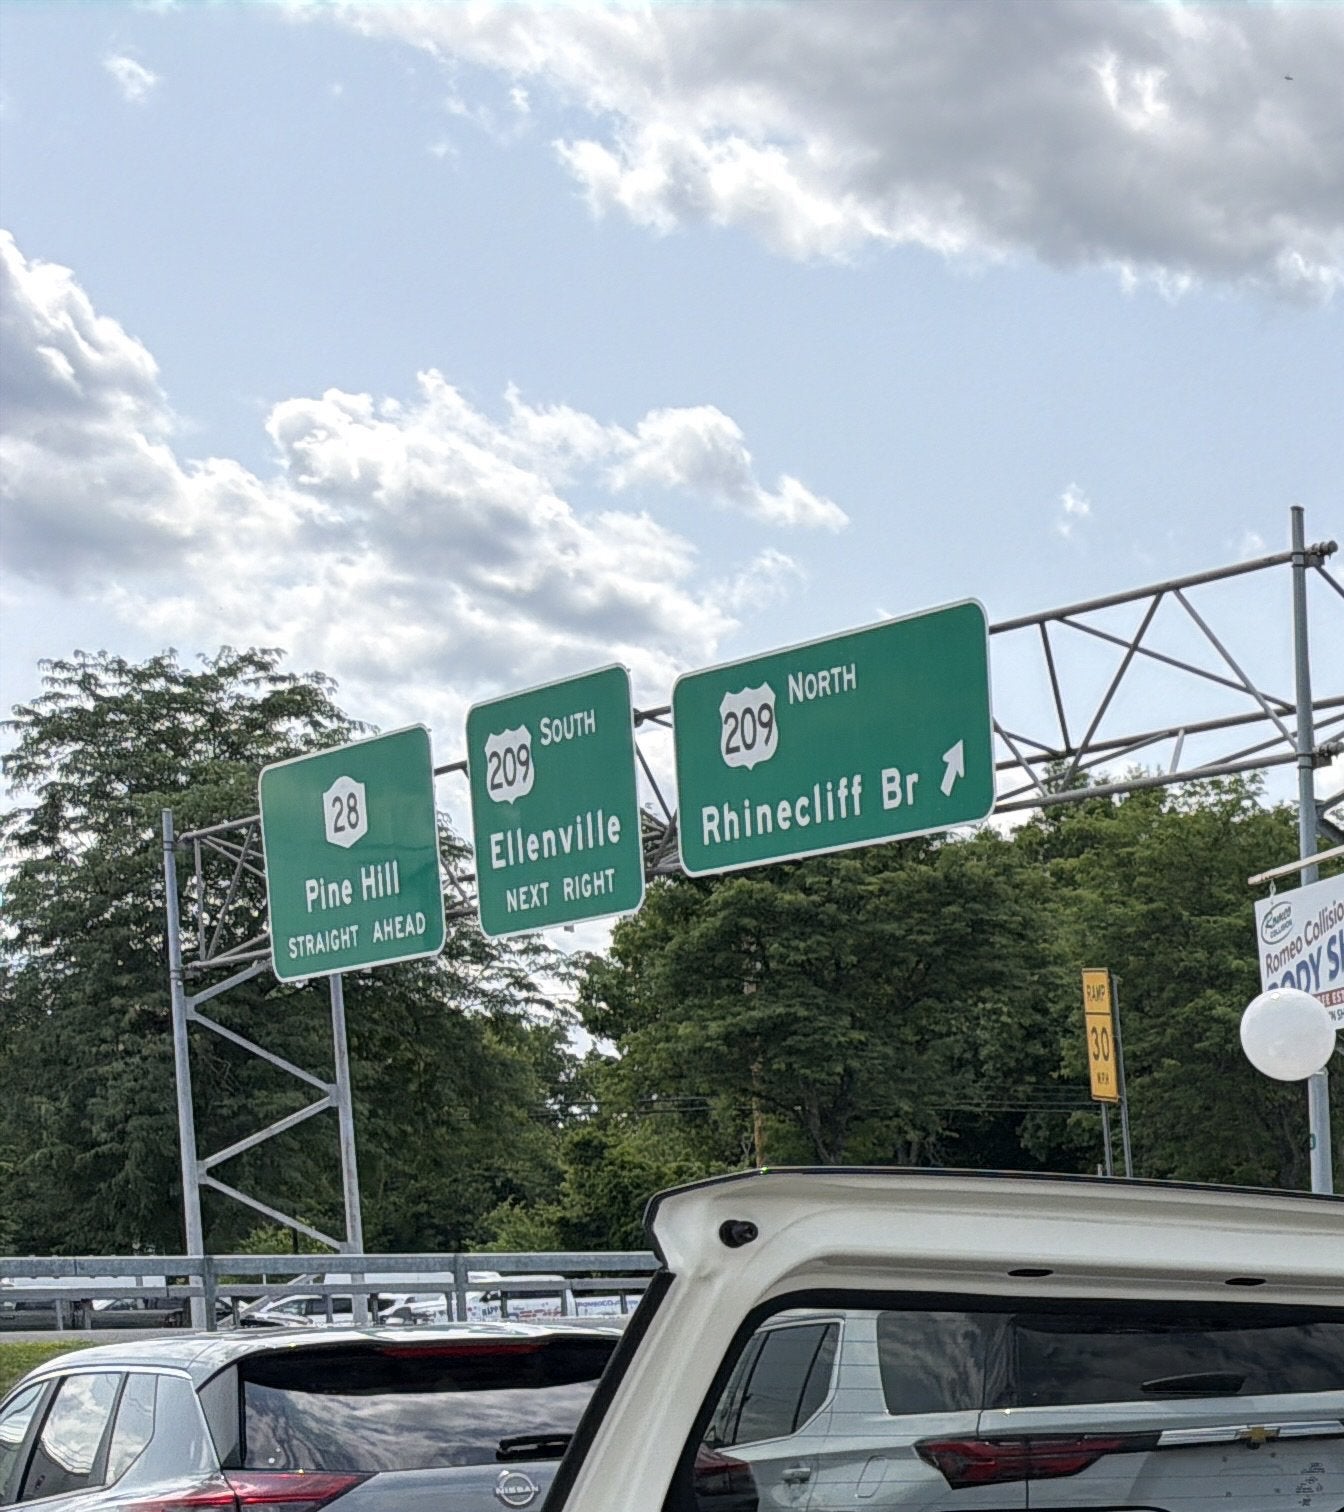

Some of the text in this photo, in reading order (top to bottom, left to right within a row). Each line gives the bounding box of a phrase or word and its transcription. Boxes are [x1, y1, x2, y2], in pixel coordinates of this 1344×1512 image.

[788, 663, 857, 705] NORTH
[539, 708, 596, 746] SOUTH
[723, 702, 774, 755] 209
[488, 743, 530, 791] 209
[331, 791, 360, 834] 28
[702, 767, 919, 846] Rhinecliff Br
[490, 808, 622, 870] Ellenville
[305, 859, 400, 913] Pine Hill
[506, 868, 615, 913] NEXT RIGHT
[288, 911, 427, 959] STRAIGHT AHEAD
[1265, 935, 1303, 979] Romeo
[1086, 984, 1106, 1001] RAMP
[1091, 1026, 1110, 1061] 30
[495, 1485, 540, 1495] NISSAN
